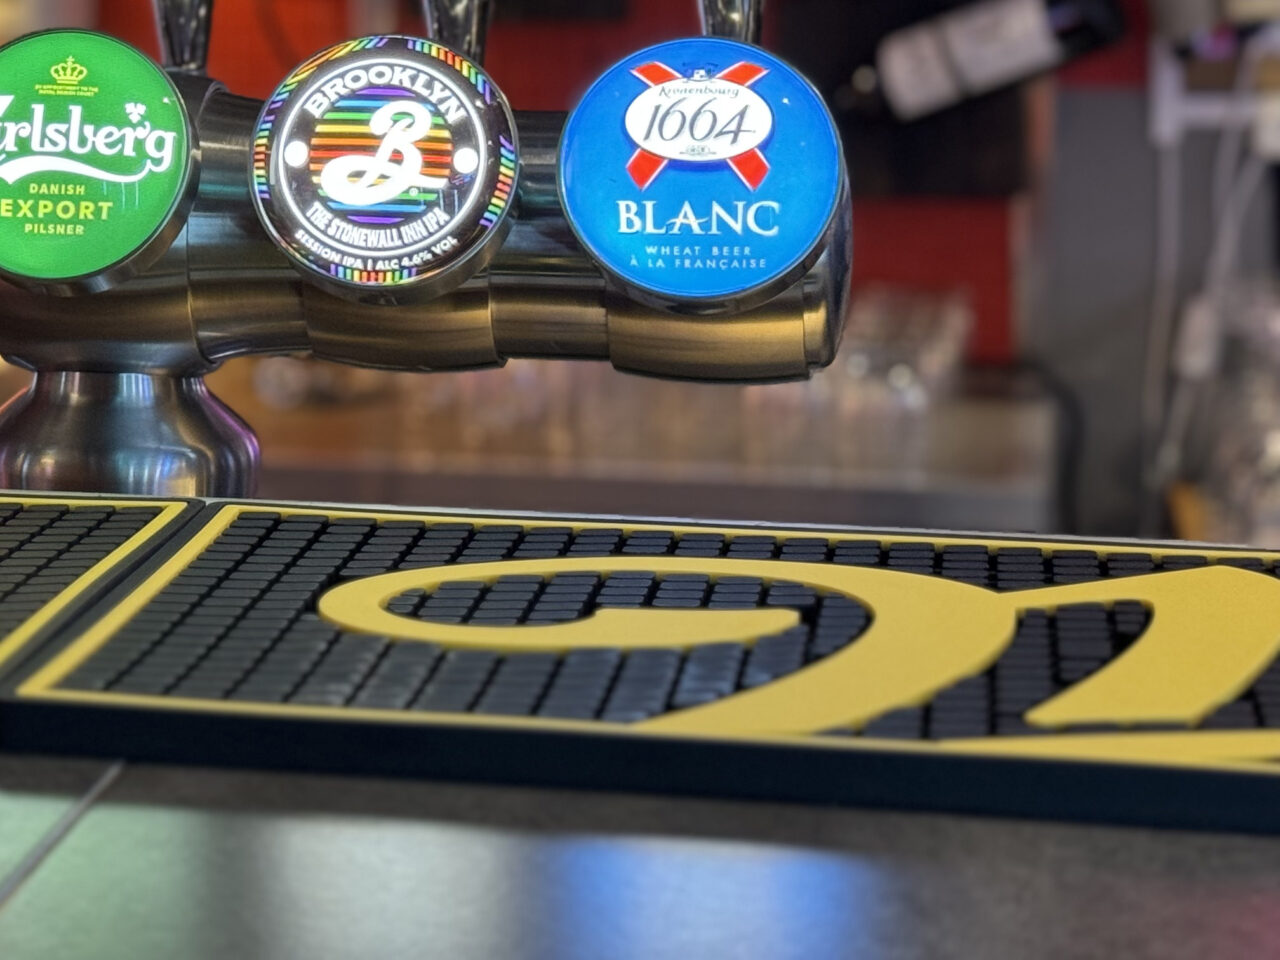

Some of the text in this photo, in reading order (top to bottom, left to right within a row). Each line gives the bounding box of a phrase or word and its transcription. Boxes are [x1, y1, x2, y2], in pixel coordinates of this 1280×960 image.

[303, 65, 468, 125] BROOKLYN
[659, 86, 739, 98] Kronenbourg
[643, 97, 756, 145] 1664
[29, 183, 85, 195] DANISH
[0, 199, 113, 220] EXPORT
[616, 200, 780, 236] BLANC
[24, 223, 84, 236] PILSNER
[306, 200, 451, 248] THE STONEWALL INN IPA
[295, 229, 341, 264] SESSION
[343, 256, 363, 270] IPA
[375, 259, 400, 270] ALC
[431, 236, 458, 256] VOL
[645, 245, 751, 256] WHEAT BEER
[648, 258, 665, 268] LA
[675, 258, 766, 270] FRANÇAISE
